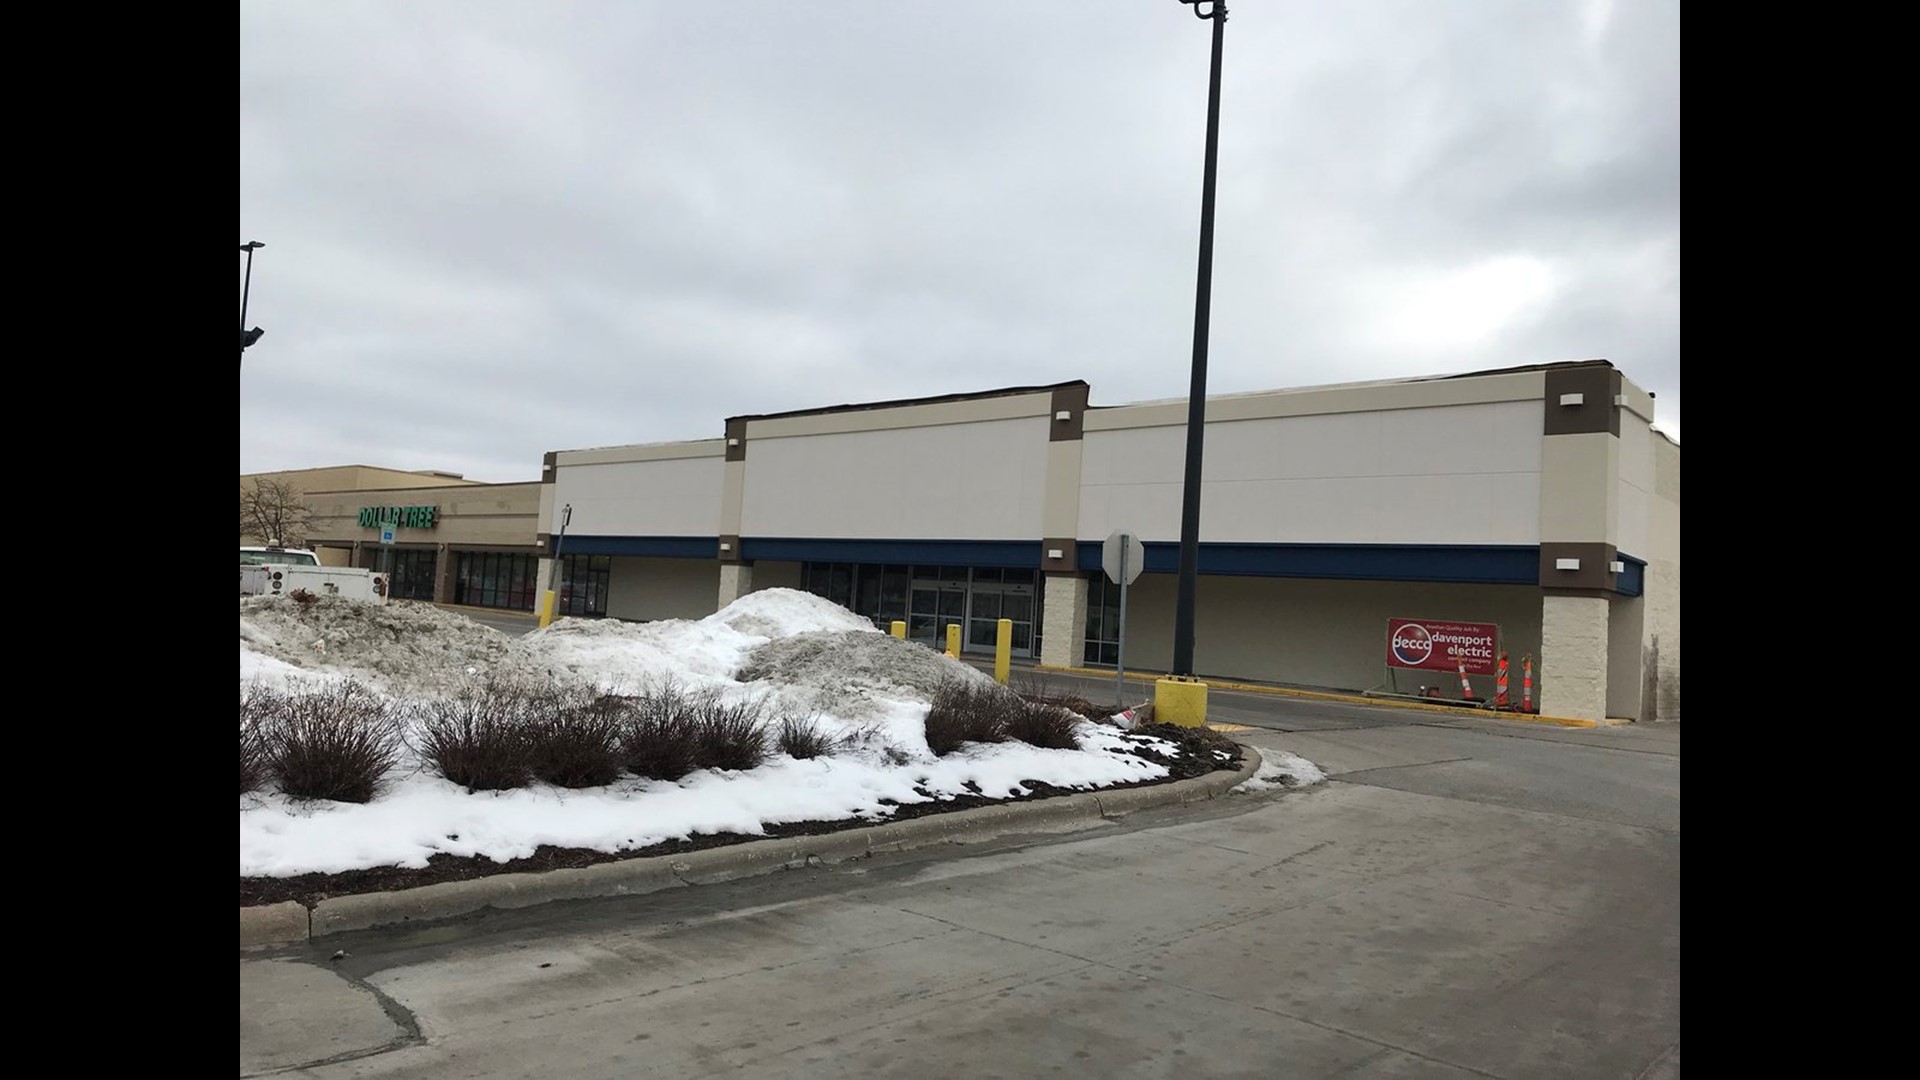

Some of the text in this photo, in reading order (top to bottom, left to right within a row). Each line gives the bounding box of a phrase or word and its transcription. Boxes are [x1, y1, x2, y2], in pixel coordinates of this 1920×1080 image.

[357, 505, 436, 528] DOLLAR TREE
[1393, 636, 1431, 650] decco
[1432, 631, 1492, 647] davenport
[1447, 644, 1492, 658] electric
